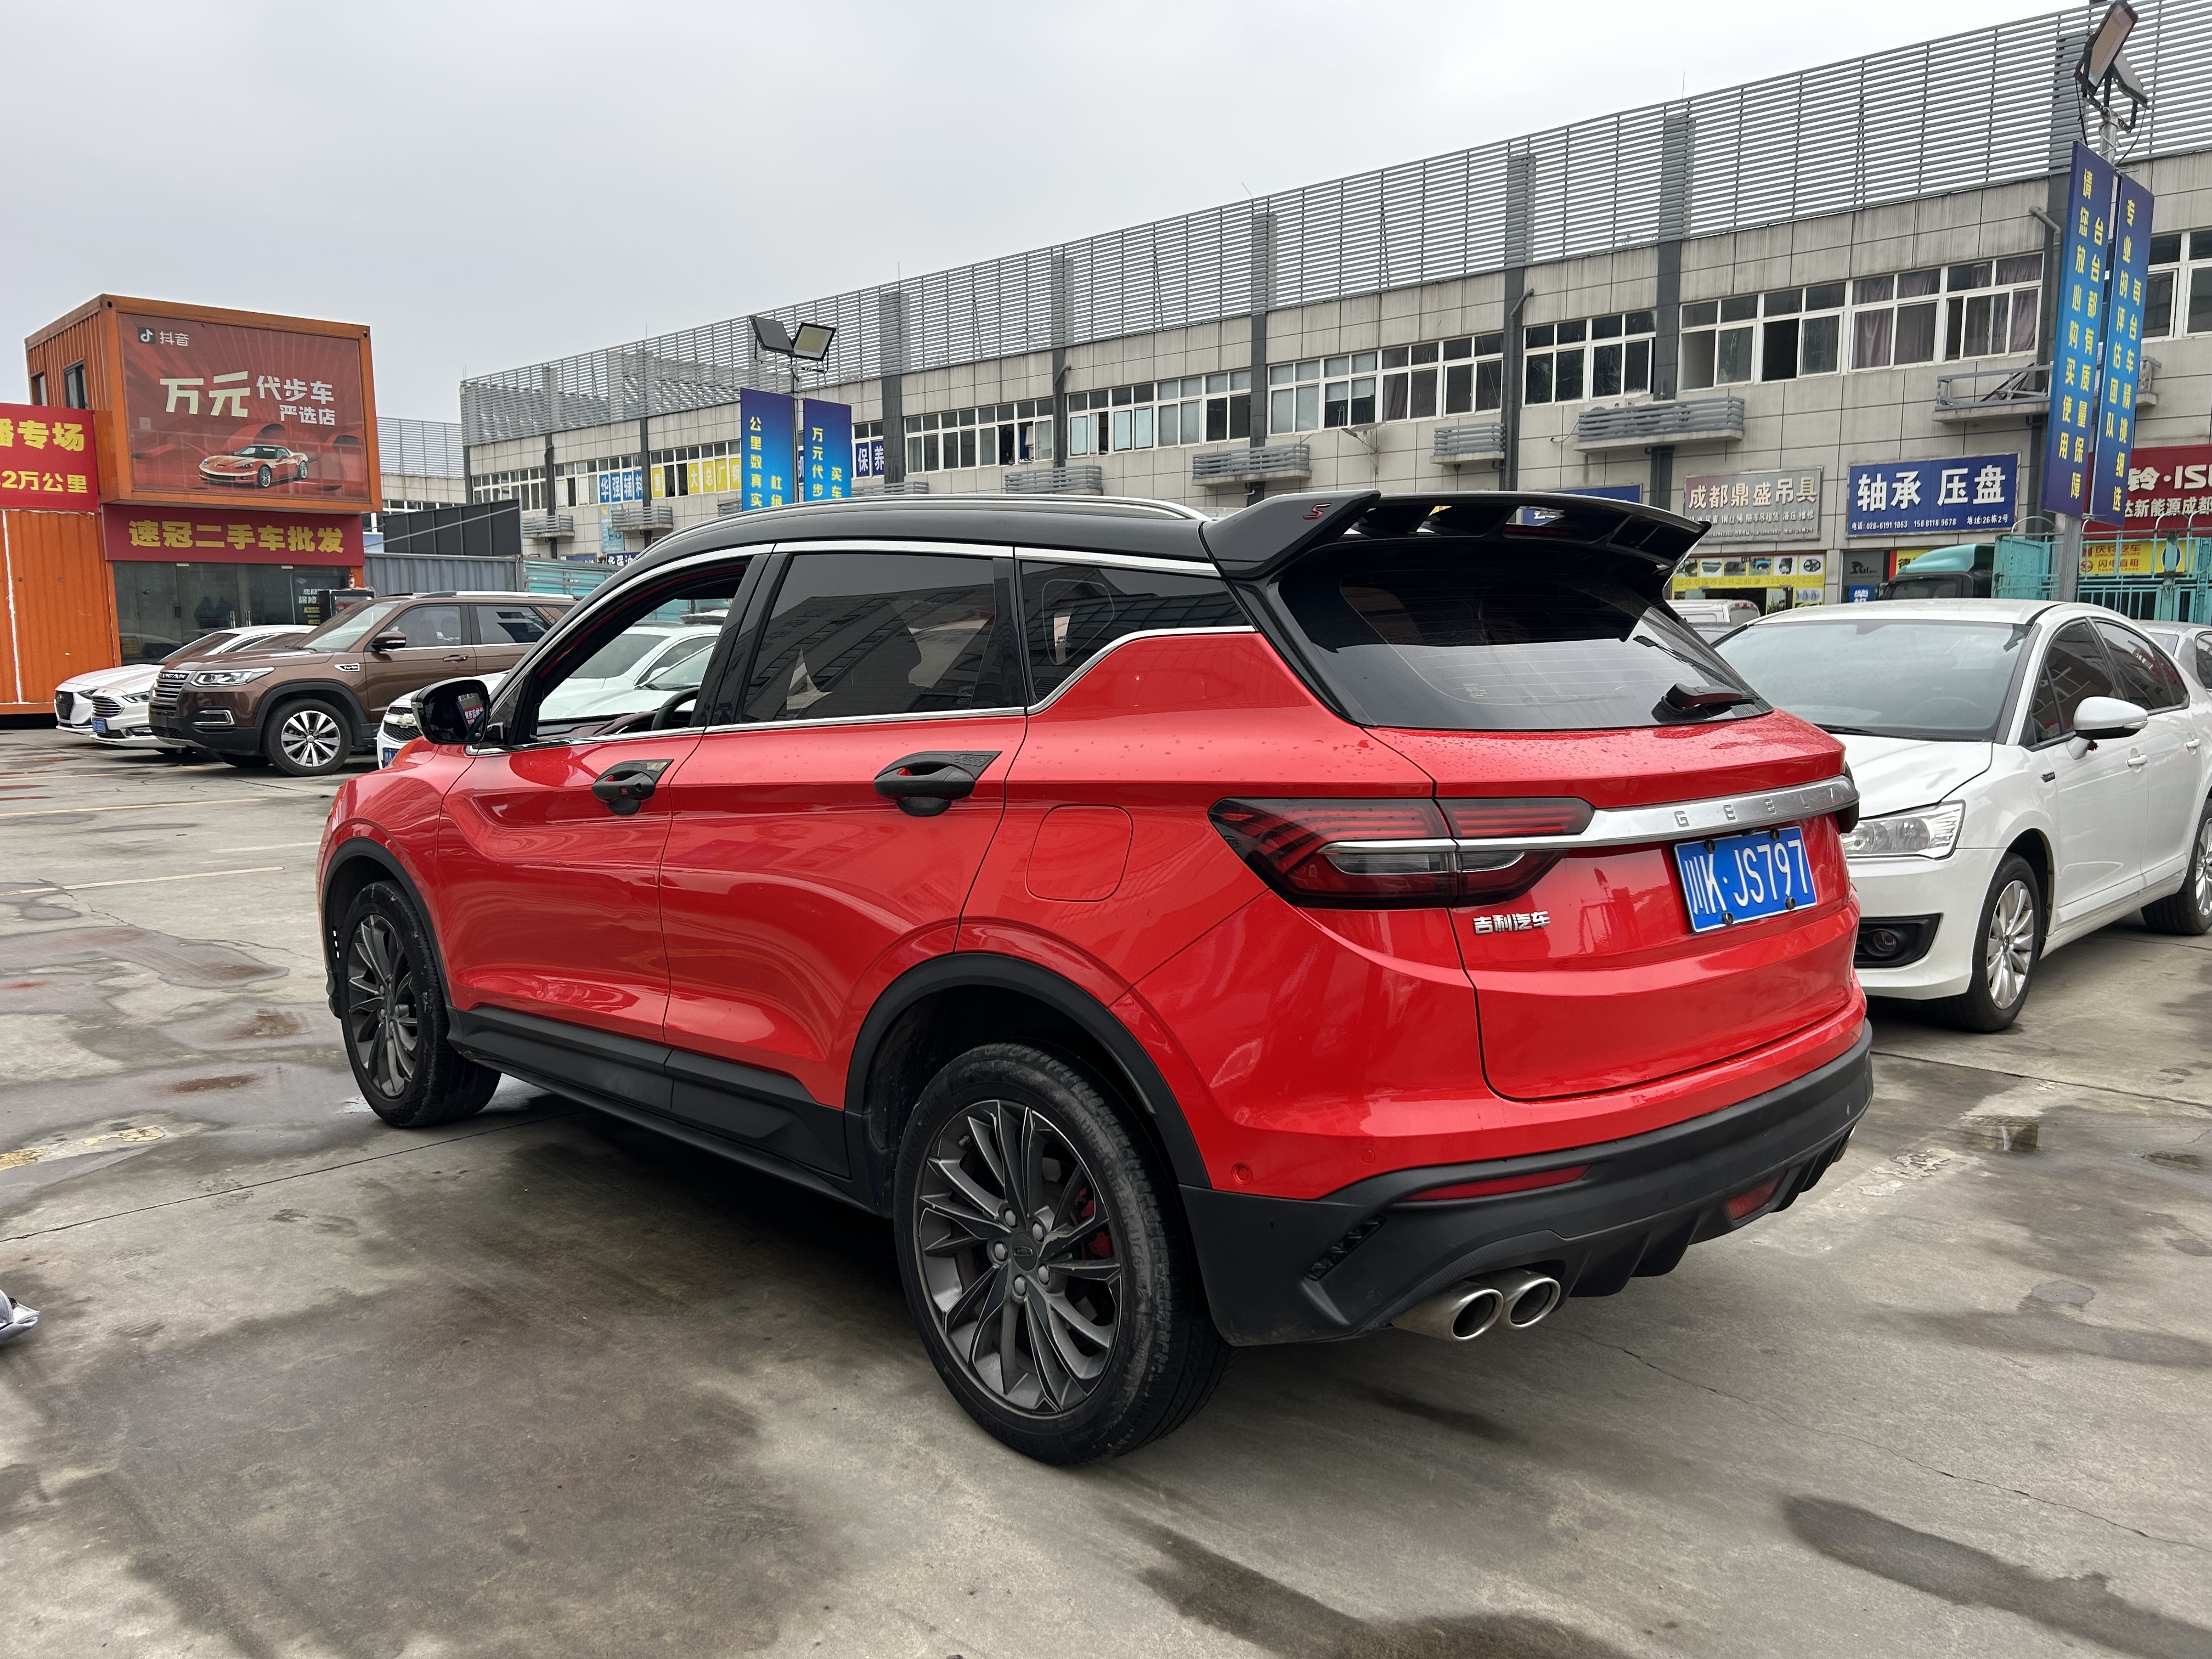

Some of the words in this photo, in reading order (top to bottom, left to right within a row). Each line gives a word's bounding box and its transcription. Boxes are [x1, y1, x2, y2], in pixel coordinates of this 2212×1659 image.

[2059, 168, 2093, 459] 请您放心购买使用
[2106, 199, 2135, 439] 专业的评估团队
[159, 331, 190, 347] 抖音
[2070, 217, 2104, 499] 台台都有质量保障
[159, 370, 251, 417] 万元
[256, 375, 335, 404] 代步车
[279, 404, 336, 426] 严选店
[749, 416, 763, 507] 公里数真实
[812, 426, 823, 498] 万元代步
[858, 445, 884, 472] 保养
[831, 467, 842, 499] 买车
[1689, 476, 1818, 510] 成都鼎盛吊具
[1857, 470, 1921, 512] 轴承
[1937, 465, 2006, 506] 压盘
[129, 520, 344, 553] 速冠二手车批发
[1683, 839, 1808, 916] 川K·JS797
[1472, 910, 1551, 935] 吉利汽车
